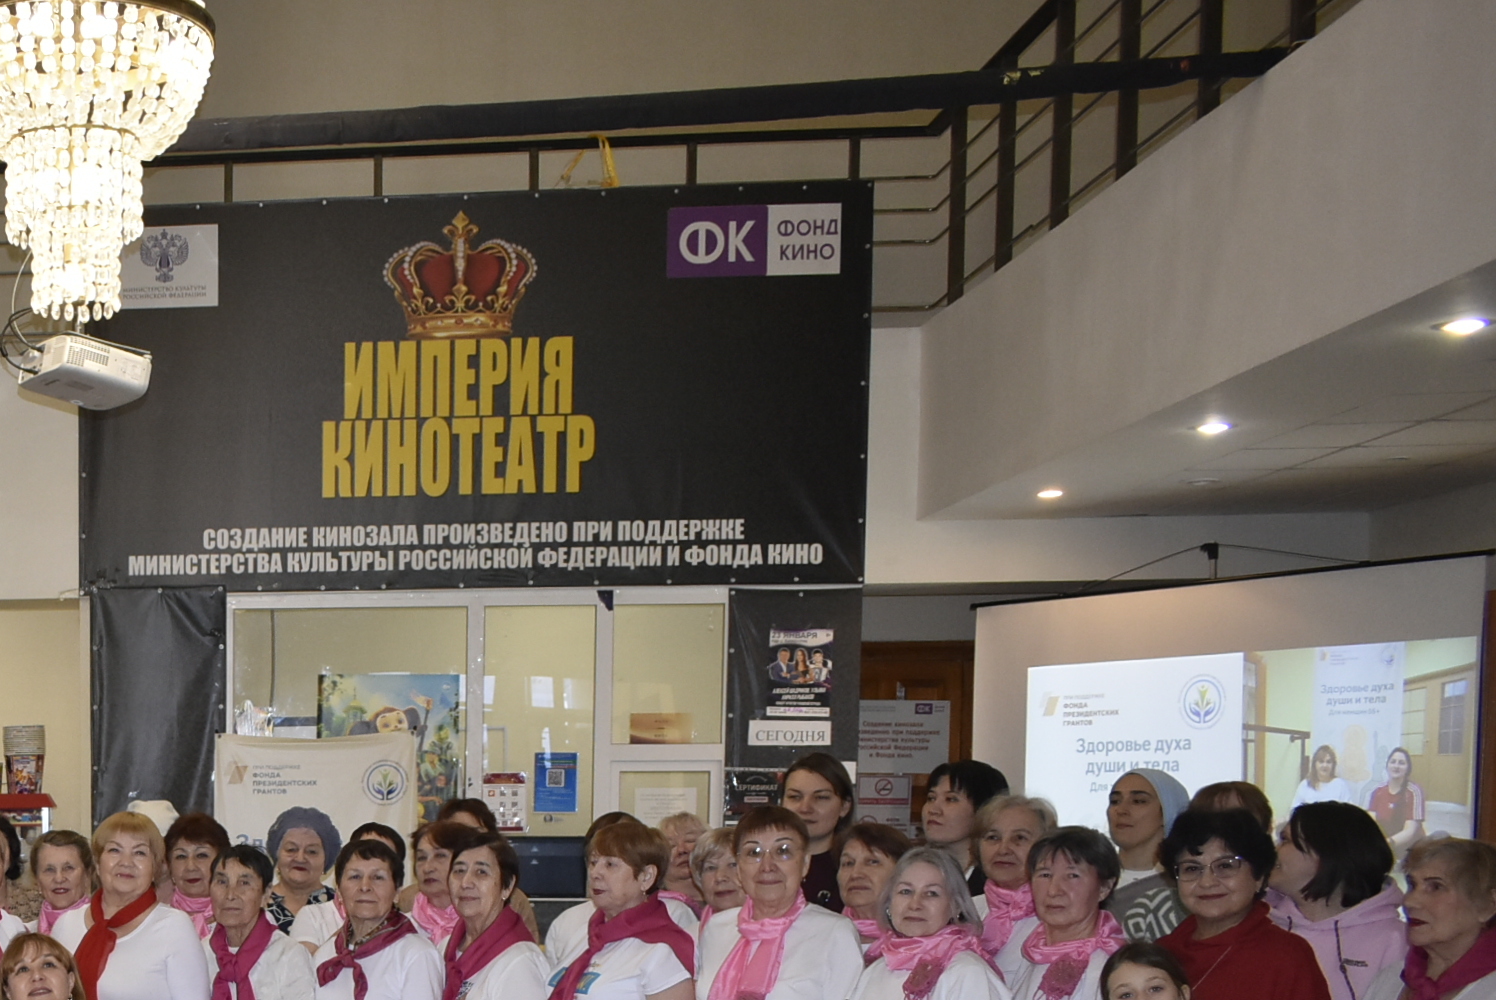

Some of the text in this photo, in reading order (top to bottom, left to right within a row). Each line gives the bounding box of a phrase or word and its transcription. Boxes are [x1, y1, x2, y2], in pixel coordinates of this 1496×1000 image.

[777, 219, 838, 237] ФОНД
[679, 220, 756, 264] ФК
[780, 243, 834, 260] КИНО
[344, 336, 574, 420] ИМПЕРИЯ
[322, 414, 595, 498] КИНОТЕАТР
[203, 519, 745, 551] СОЗДАНИЕ КИНОЗАЛА ПРОИЗВЕДЕНО ПРИ ПОДДЕРЖКЕ
[128, 543, 823, 576] МИНИСТЕРСТВА КУЛЬТУРЫ РОССИЙСКОЙ ФЕДЕРАЦИИ И ФОНДА КИНО
[1321, 683, 1394, 694] Здоровье духа
[1326, 697, 1353, 706] души
[1063, 710, 1119, 718] ПРЕЗИДЕНТСКИХ
[756, 730, 825, 743] СЕГОДНЯ
[1076, 738, 1191, 756] Здоровье духа
[1086, 760, 1179, 775] души и тела
[1090, 782, 1108, 793] Для
